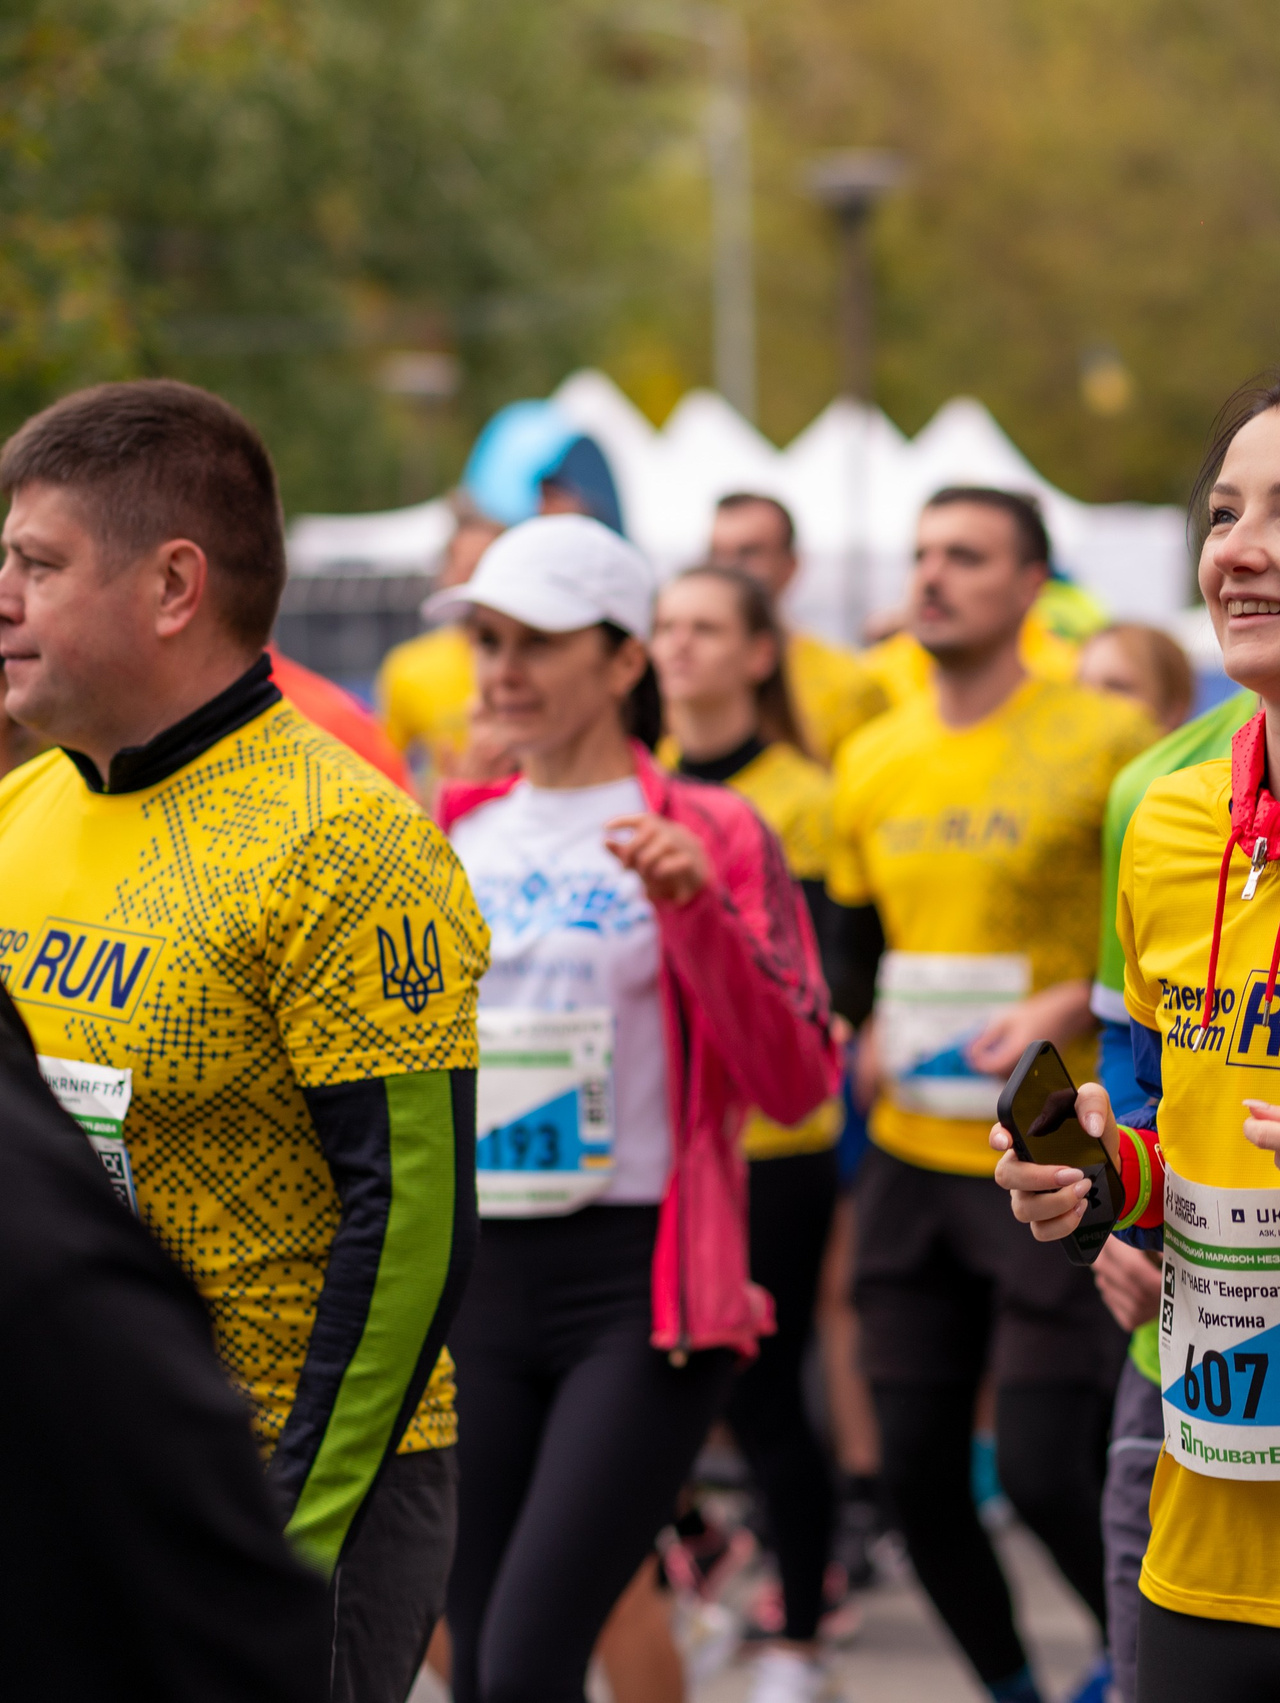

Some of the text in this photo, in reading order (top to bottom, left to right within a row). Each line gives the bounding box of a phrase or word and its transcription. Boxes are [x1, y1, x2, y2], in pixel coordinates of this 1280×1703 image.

[22, 929, 150, 1009] RUN
[1167, 1015, 1225, 1051] Atom
[478, 1124, 560, 1169] 193
[1205, 1252, 1254, 1264] МАРАФОН
[1198, 1306, 1265, 1329] Христина
